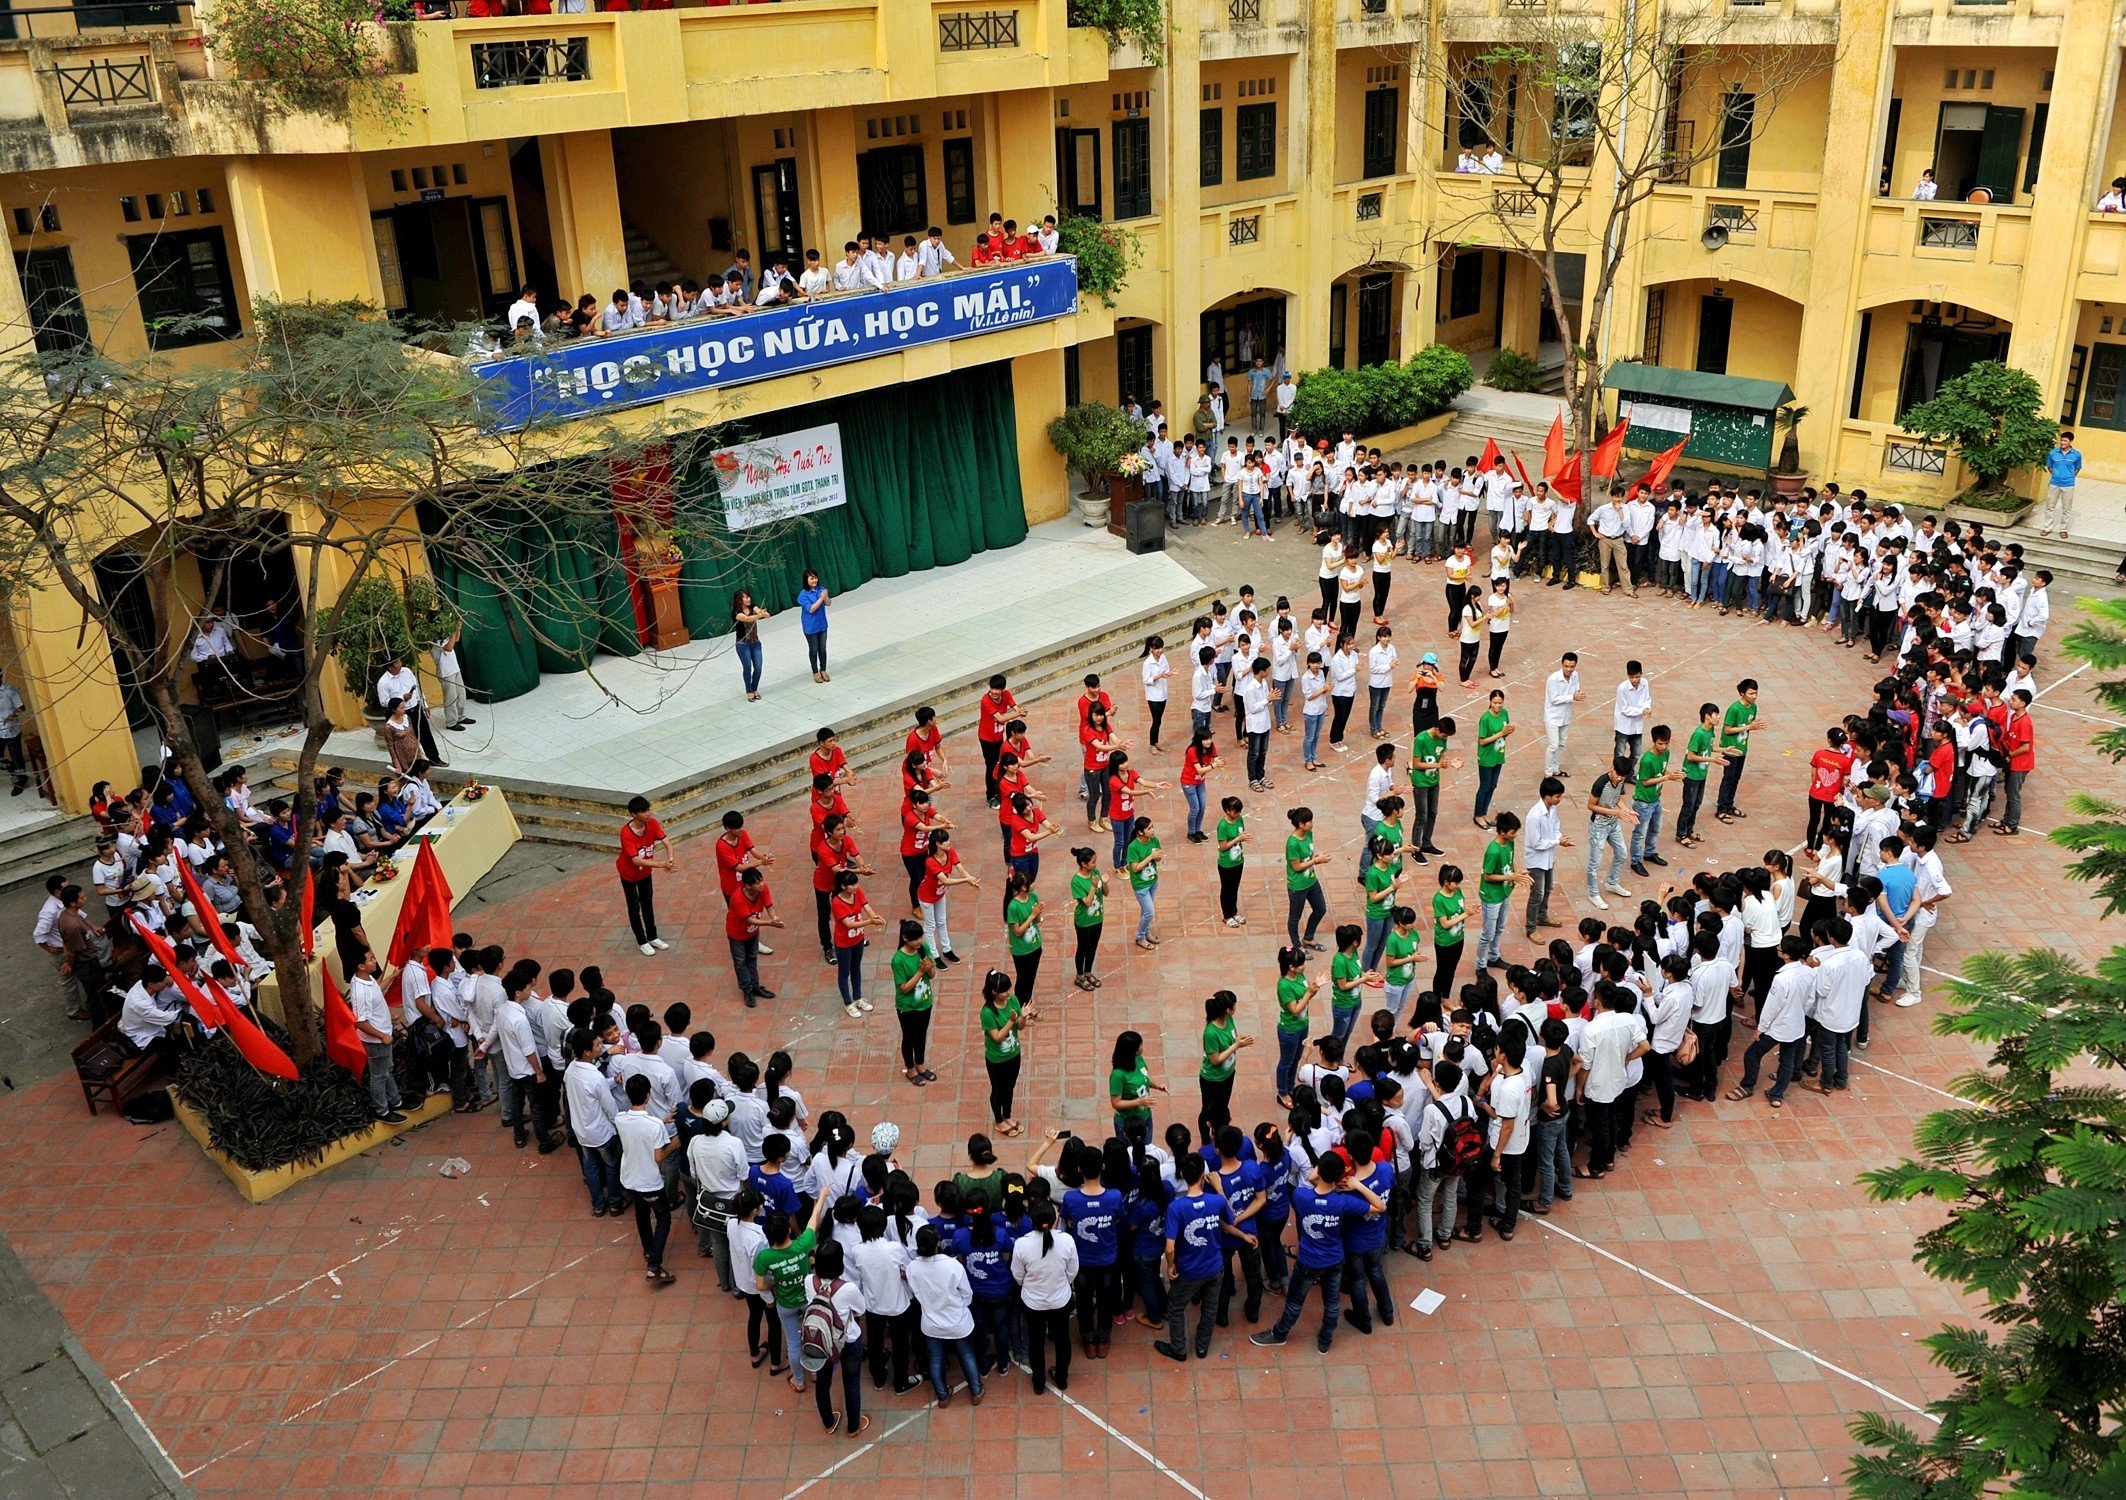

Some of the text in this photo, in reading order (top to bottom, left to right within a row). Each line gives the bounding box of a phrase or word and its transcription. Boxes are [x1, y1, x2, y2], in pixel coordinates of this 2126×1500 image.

[667, 336, 754, 377] HỌC
[863, 302, 939, 340] HỌC
[793, 447, 814, 471] Tuổi
[816, 444, 833, 466] Trẻ
[774, 485, 790, 500] TRUNG
[790, 482, 801, 495] TÂM
[815, 476, 830, 489] THANH
